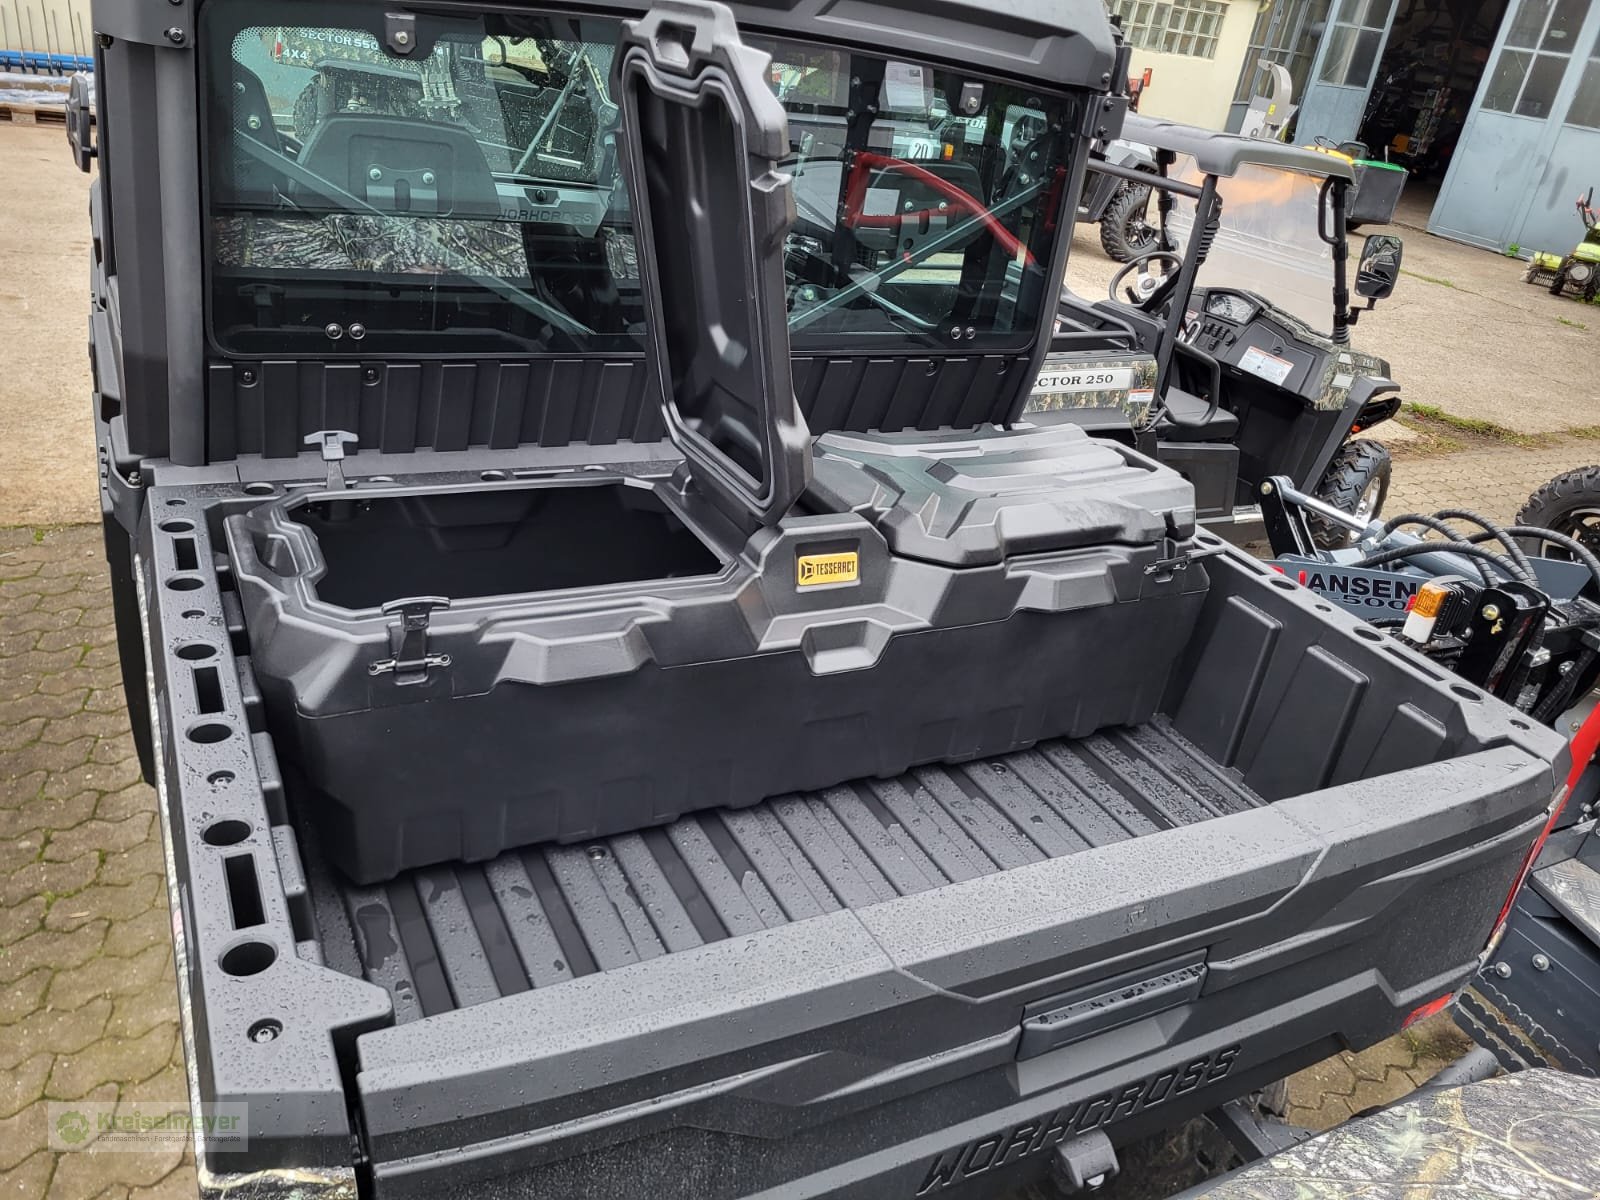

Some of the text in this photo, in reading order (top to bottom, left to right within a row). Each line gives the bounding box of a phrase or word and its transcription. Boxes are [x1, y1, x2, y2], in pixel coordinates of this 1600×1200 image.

[300, 30, 352, 46] SECTOR
[282, 48, 308, 60] 4X4
[914, 142, 929, 159] 20
[1033, 374, 1114, 387] CTOR 250
[815, 560, 856, 576] TESSERACT
[915, 1045, 1241, 1196] WORKCROSS
